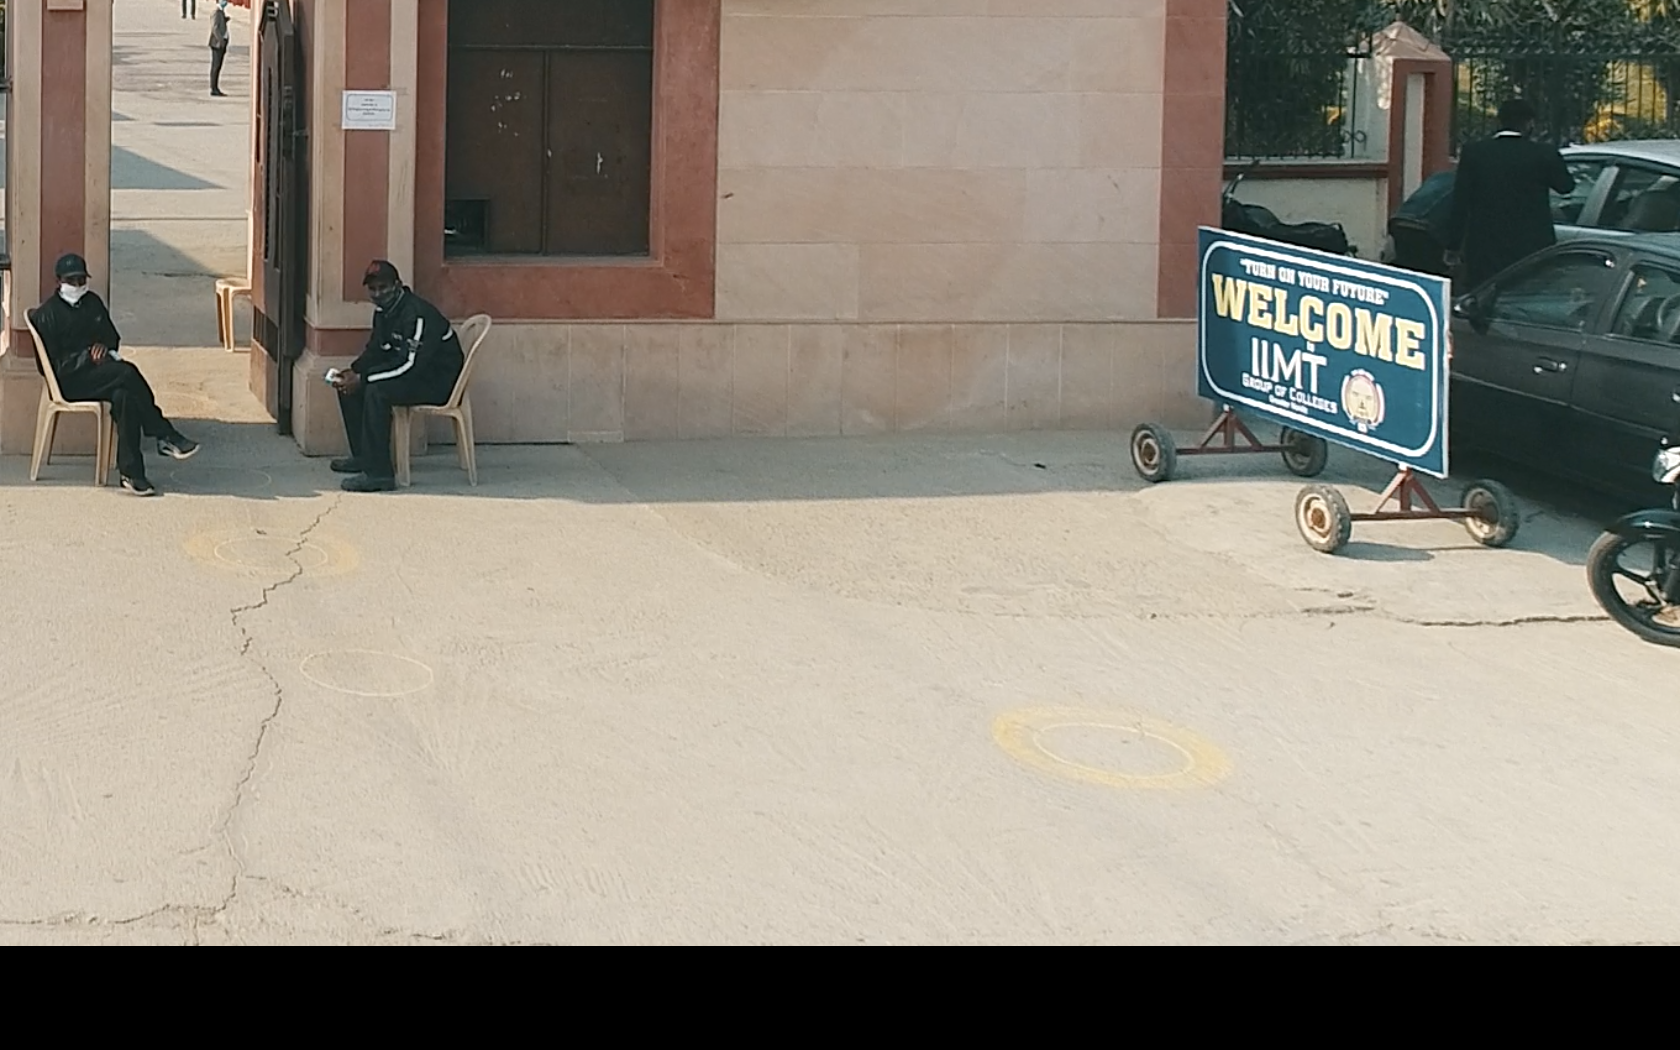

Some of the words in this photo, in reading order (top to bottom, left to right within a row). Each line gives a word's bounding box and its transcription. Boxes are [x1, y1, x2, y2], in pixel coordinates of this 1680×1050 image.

[1278, 267, 1296, 285] ON
[1297, 271, 1330, 292] YOUR
[1211, 273, 1426, 371] WELCOME
[1251, 336, 1328, 395] IIMT
